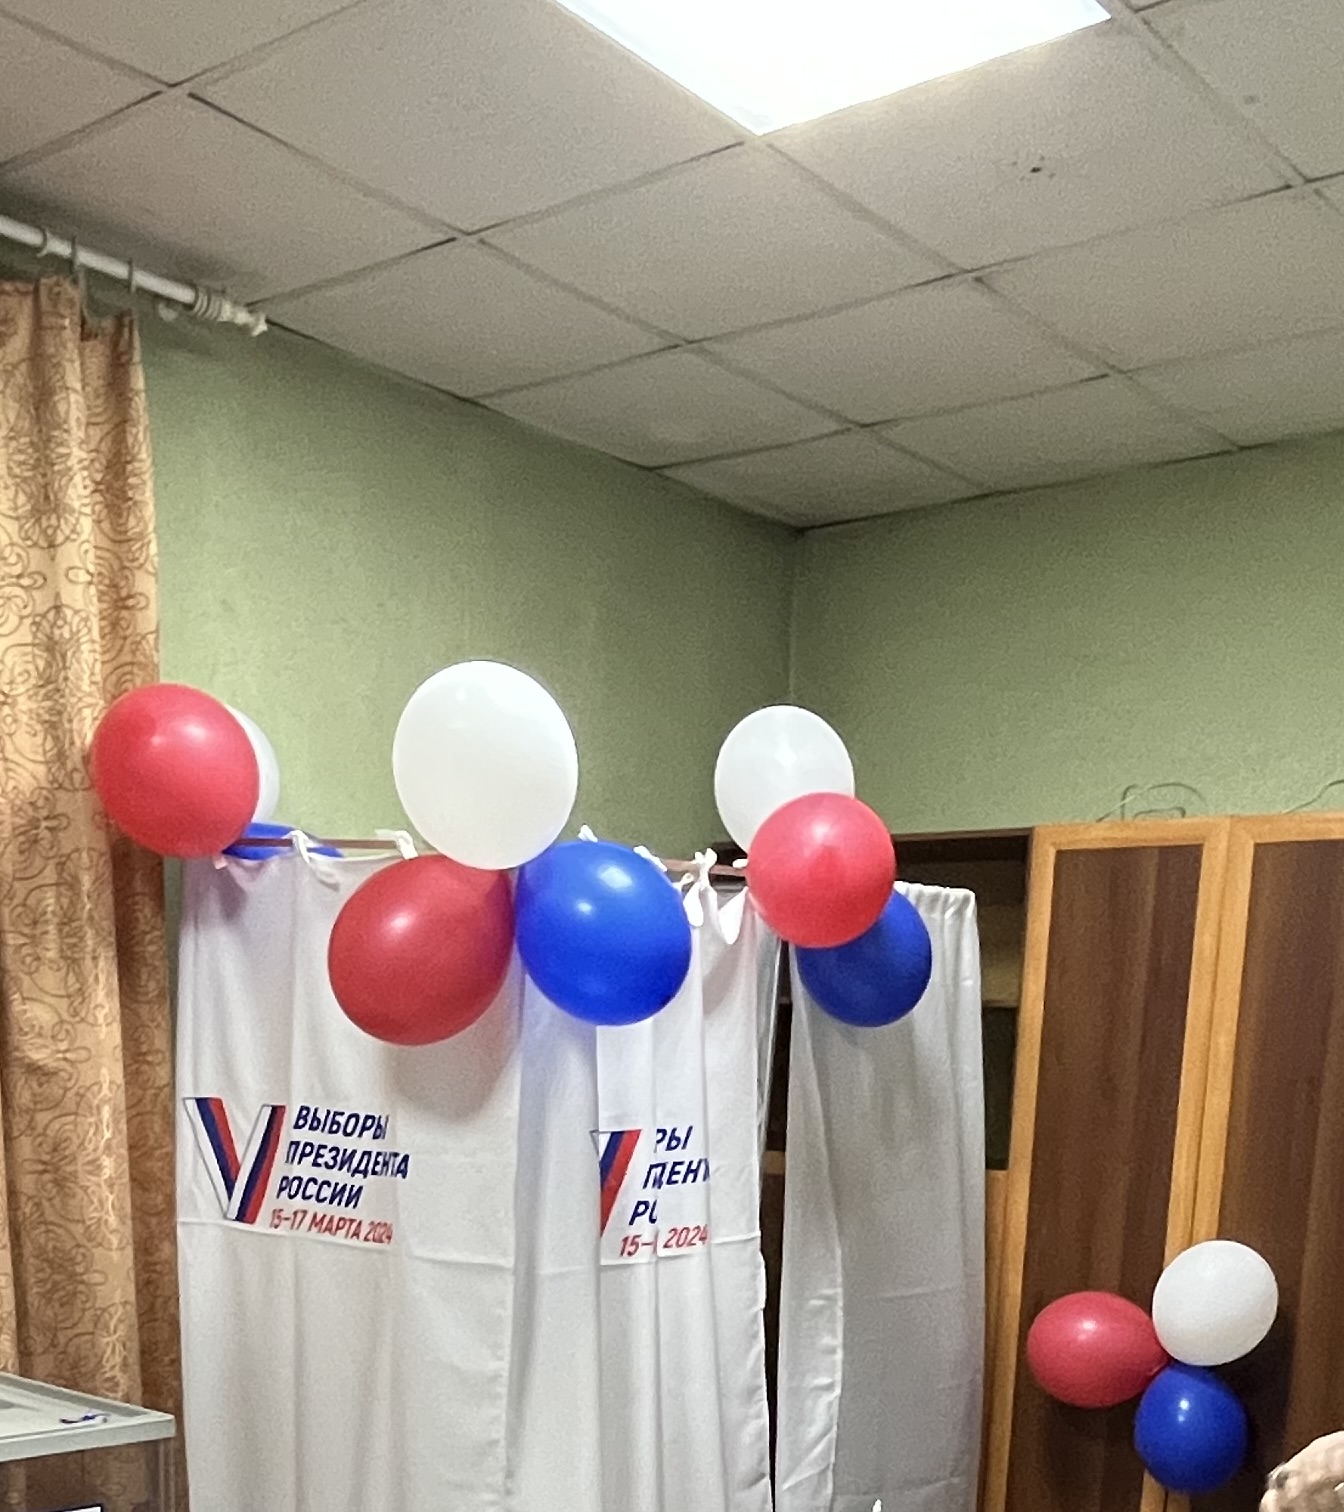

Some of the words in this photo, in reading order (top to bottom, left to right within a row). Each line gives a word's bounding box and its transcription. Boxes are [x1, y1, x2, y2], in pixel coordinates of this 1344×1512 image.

[292, 1105, 390, 1140] ВЫБОРЫ
[285, 1140, 410, 1179] ПРЕЗИДЕНТА
[276, 1175, 364, 1209] РОССИИ
[307, 1212, 362, 1240] МАРТА
[363, 1220, 394, 1245] 2024
[662, 1224, 708, 1249] 2024
